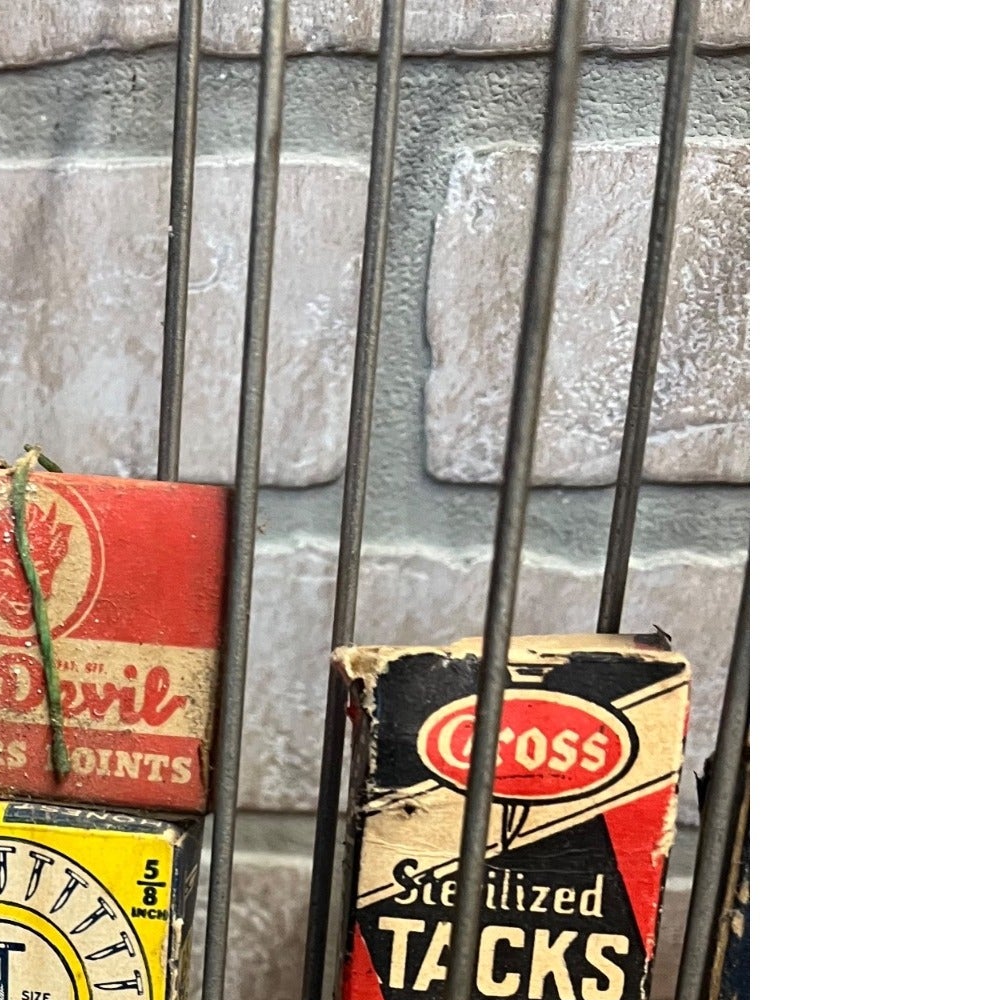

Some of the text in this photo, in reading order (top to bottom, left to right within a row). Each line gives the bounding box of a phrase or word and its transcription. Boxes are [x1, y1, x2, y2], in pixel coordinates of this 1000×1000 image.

[46, 742, 193, 785] OINTS
[392, 858, 605, 918] Steilized
[131, 906, 167, 921] INCH
